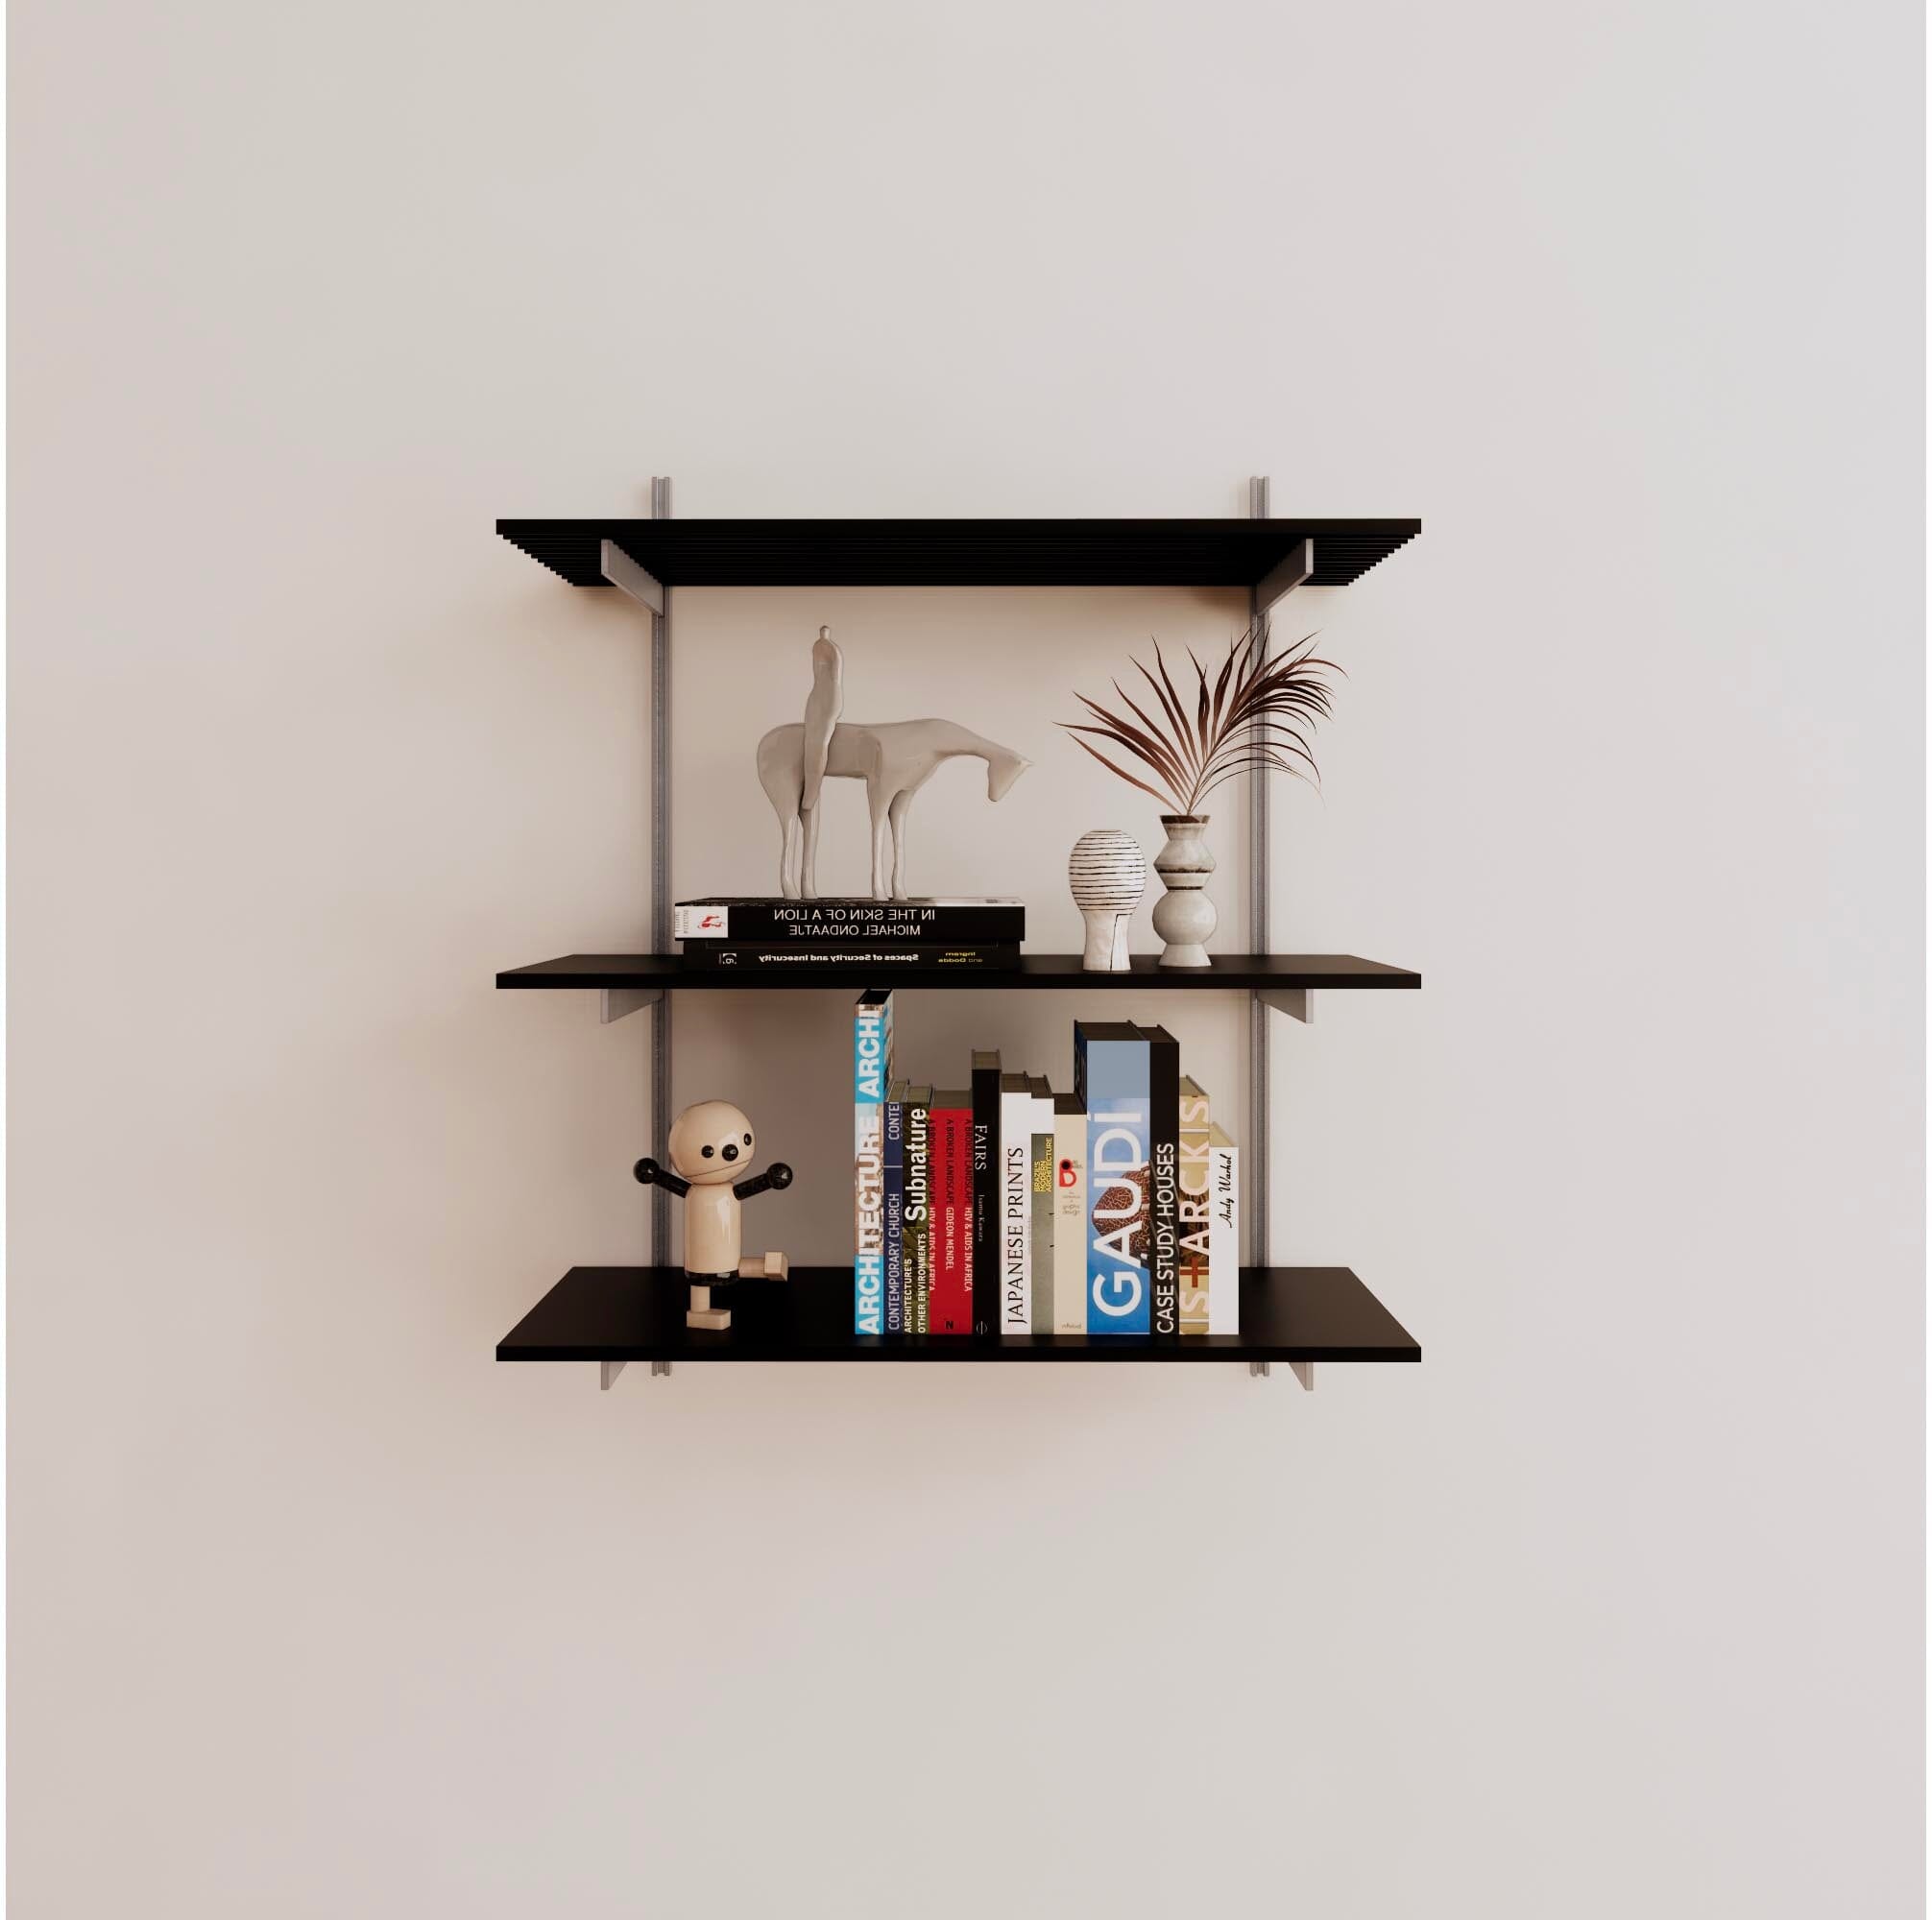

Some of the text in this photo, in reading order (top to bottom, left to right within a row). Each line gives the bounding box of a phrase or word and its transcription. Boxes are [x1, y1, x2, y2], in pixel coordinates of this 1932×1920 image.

[905, 1108, 928, 1222] Subnature
[975, 1124, 988, 1170] FAIRS
[858, 1116, 881, 1334] ARCHITECTURE
[888, 1193, 900, 1237] CHURCH
[964, 1207, 973, 1222] HIV
[1218, 1153, 1235, 1229] Andy Warhol
[946, 1207, 954, 1271] GIDEON MENDEL
[964, 1231, 973, 1251] AIDS
[964, 1252, 973, 1262] IN
[1007, 1147, 1027, 1325] JAPANESE PRINTS
[1156, 1142, 1174, 1334] CASE STUDY HOUSES
[888, 1241, 900, 1331] CONTEMPORARY
[904, 1259, 912, 1333] ARCHITECTURE'S
[917, 1233, 927, 1333] OTHER ENVIRONMENTS
[964, 1262, 973, 1291] AFRICA
